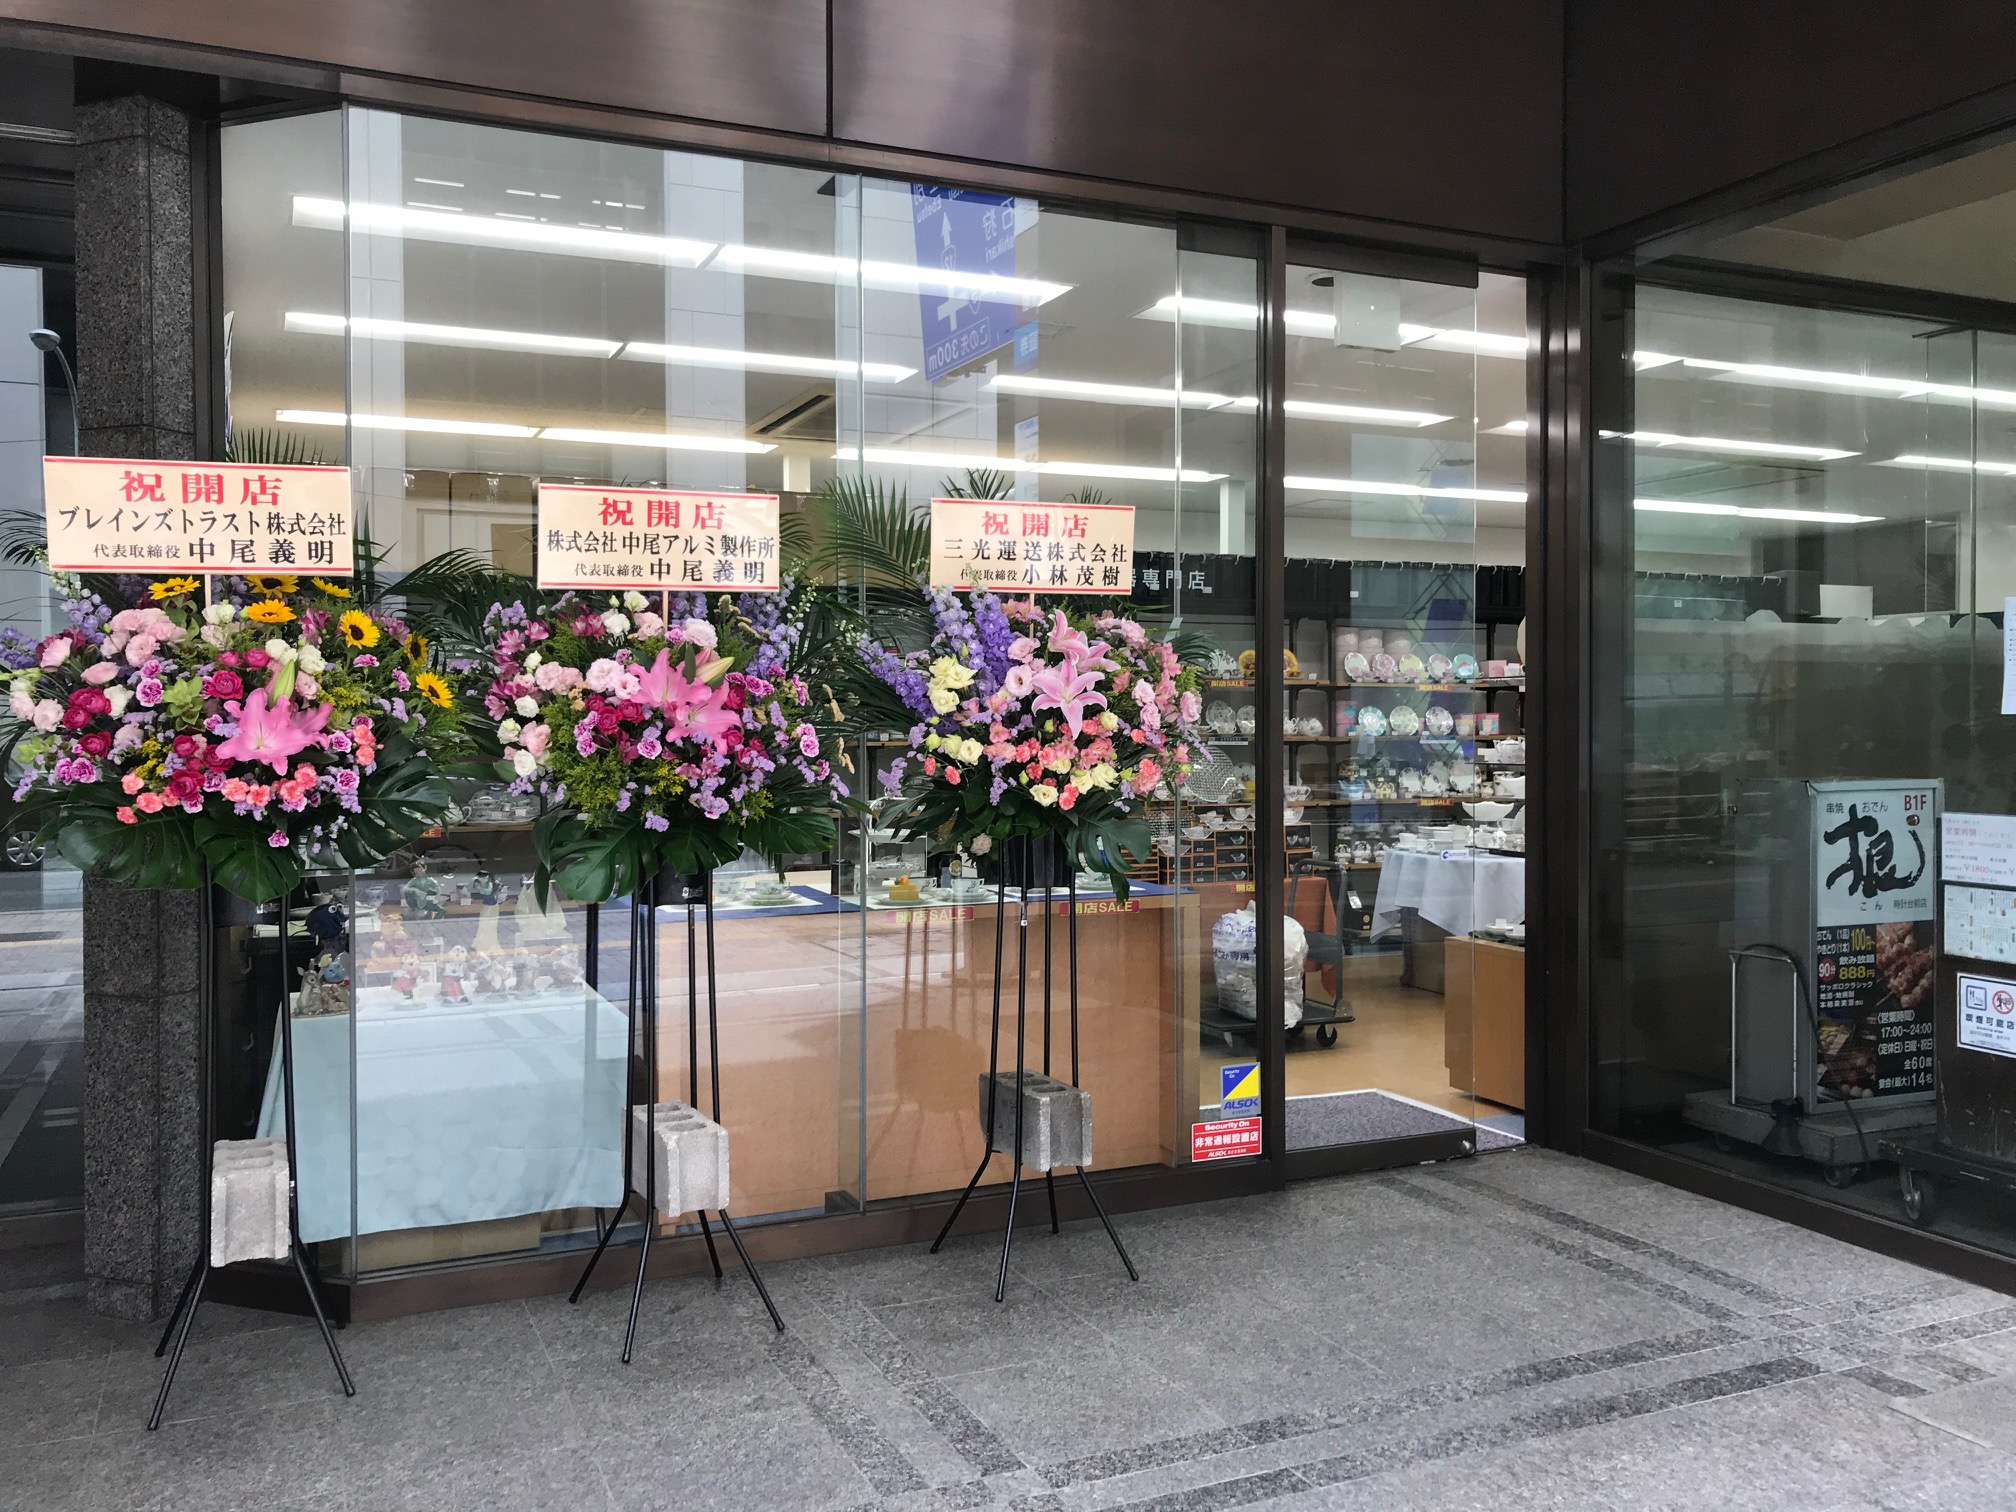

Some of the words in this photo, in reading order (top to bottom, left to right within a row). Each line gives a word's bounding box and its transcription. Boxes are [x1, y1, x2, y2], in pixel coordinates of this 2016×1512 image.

[119, 470, 283, 505] 祝開店
[58, 505, 347, 537] ブレインズトラスト株式会社
[598, 497, 727, 530] 祝開店
[981, 510, 1089, 538] 祝開店
[93, 543, 181, 559] 代表取締役
[188, 537, 334, 565] 中尾義明
[547, 529, 775, 559] 株式会社中尾アルミ製作所
[943, 538, 1128, 563] 三光運送株式会社
[574, 562, 644, 577] 代表取締役
[650, 557, 765, 583] 中尾義明
[1022, 564, 1120, 587] 小林茂樹
[1826, 802, 1844, 814] 串焼
[1862, 801, 1888, 813] おでん
[1904, 794, 1927, 811] B1F
[1818, 962, 1836, 977] 90分
[1839, 965, 1876, 980] 888円
[1820, 981, 1873, 992] サッポロクラシック
[1965, 1013, 2015, 1030] 喫煙可能店
[1223, 1098, 1259, 1110] ALSOK
[1204, 1121, 1238, 1132] Security
[1238, 1120, 1250, 1128] On
[1195, 1131, 1259, 1148] 非常通報設置店
[1207, 1150, 1227, 1158] ALSOK
